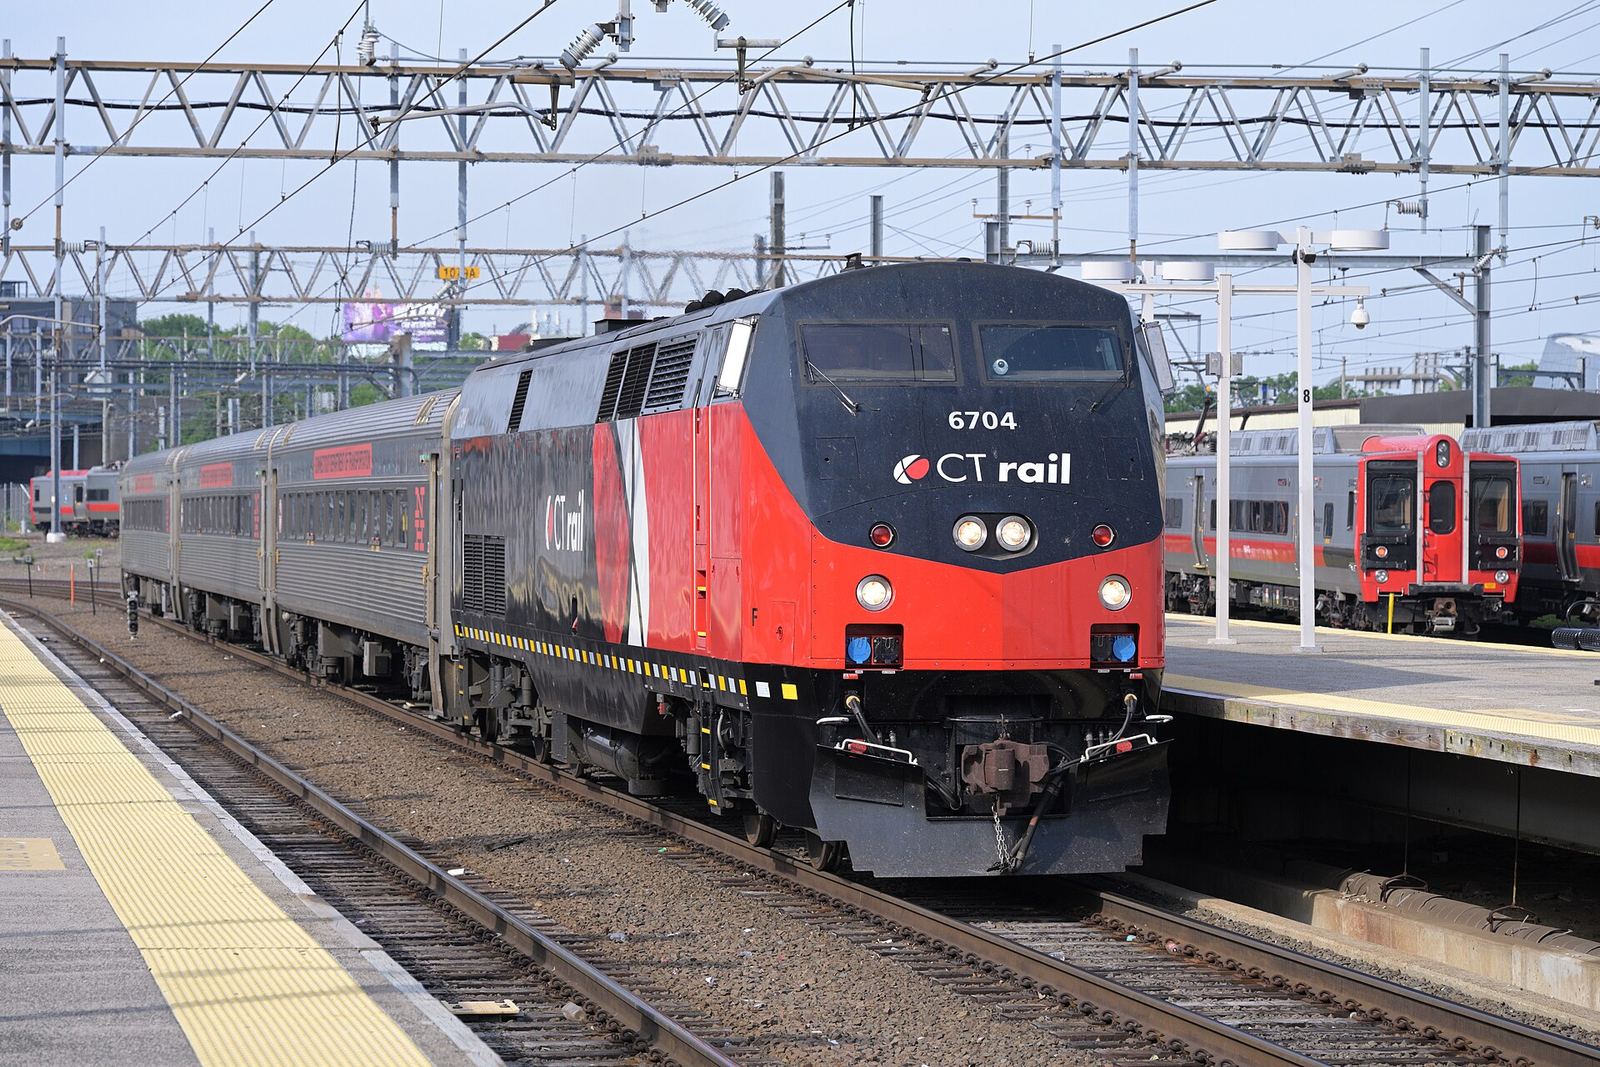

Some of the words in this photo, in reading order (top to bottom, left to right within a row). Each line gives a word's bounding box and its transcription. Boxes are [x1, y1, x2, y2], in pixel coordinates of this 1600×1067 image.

[1303, 389, 1310, 403] 8
[948, 411, 1018, 430] 6704
[936, 453, 987, 483] CT
[998, 453, 1071, 484] rail
[554, 495, 566, 551] CT
[566, 489, 584, 552] rail
[752, 608, 758, 627] F
